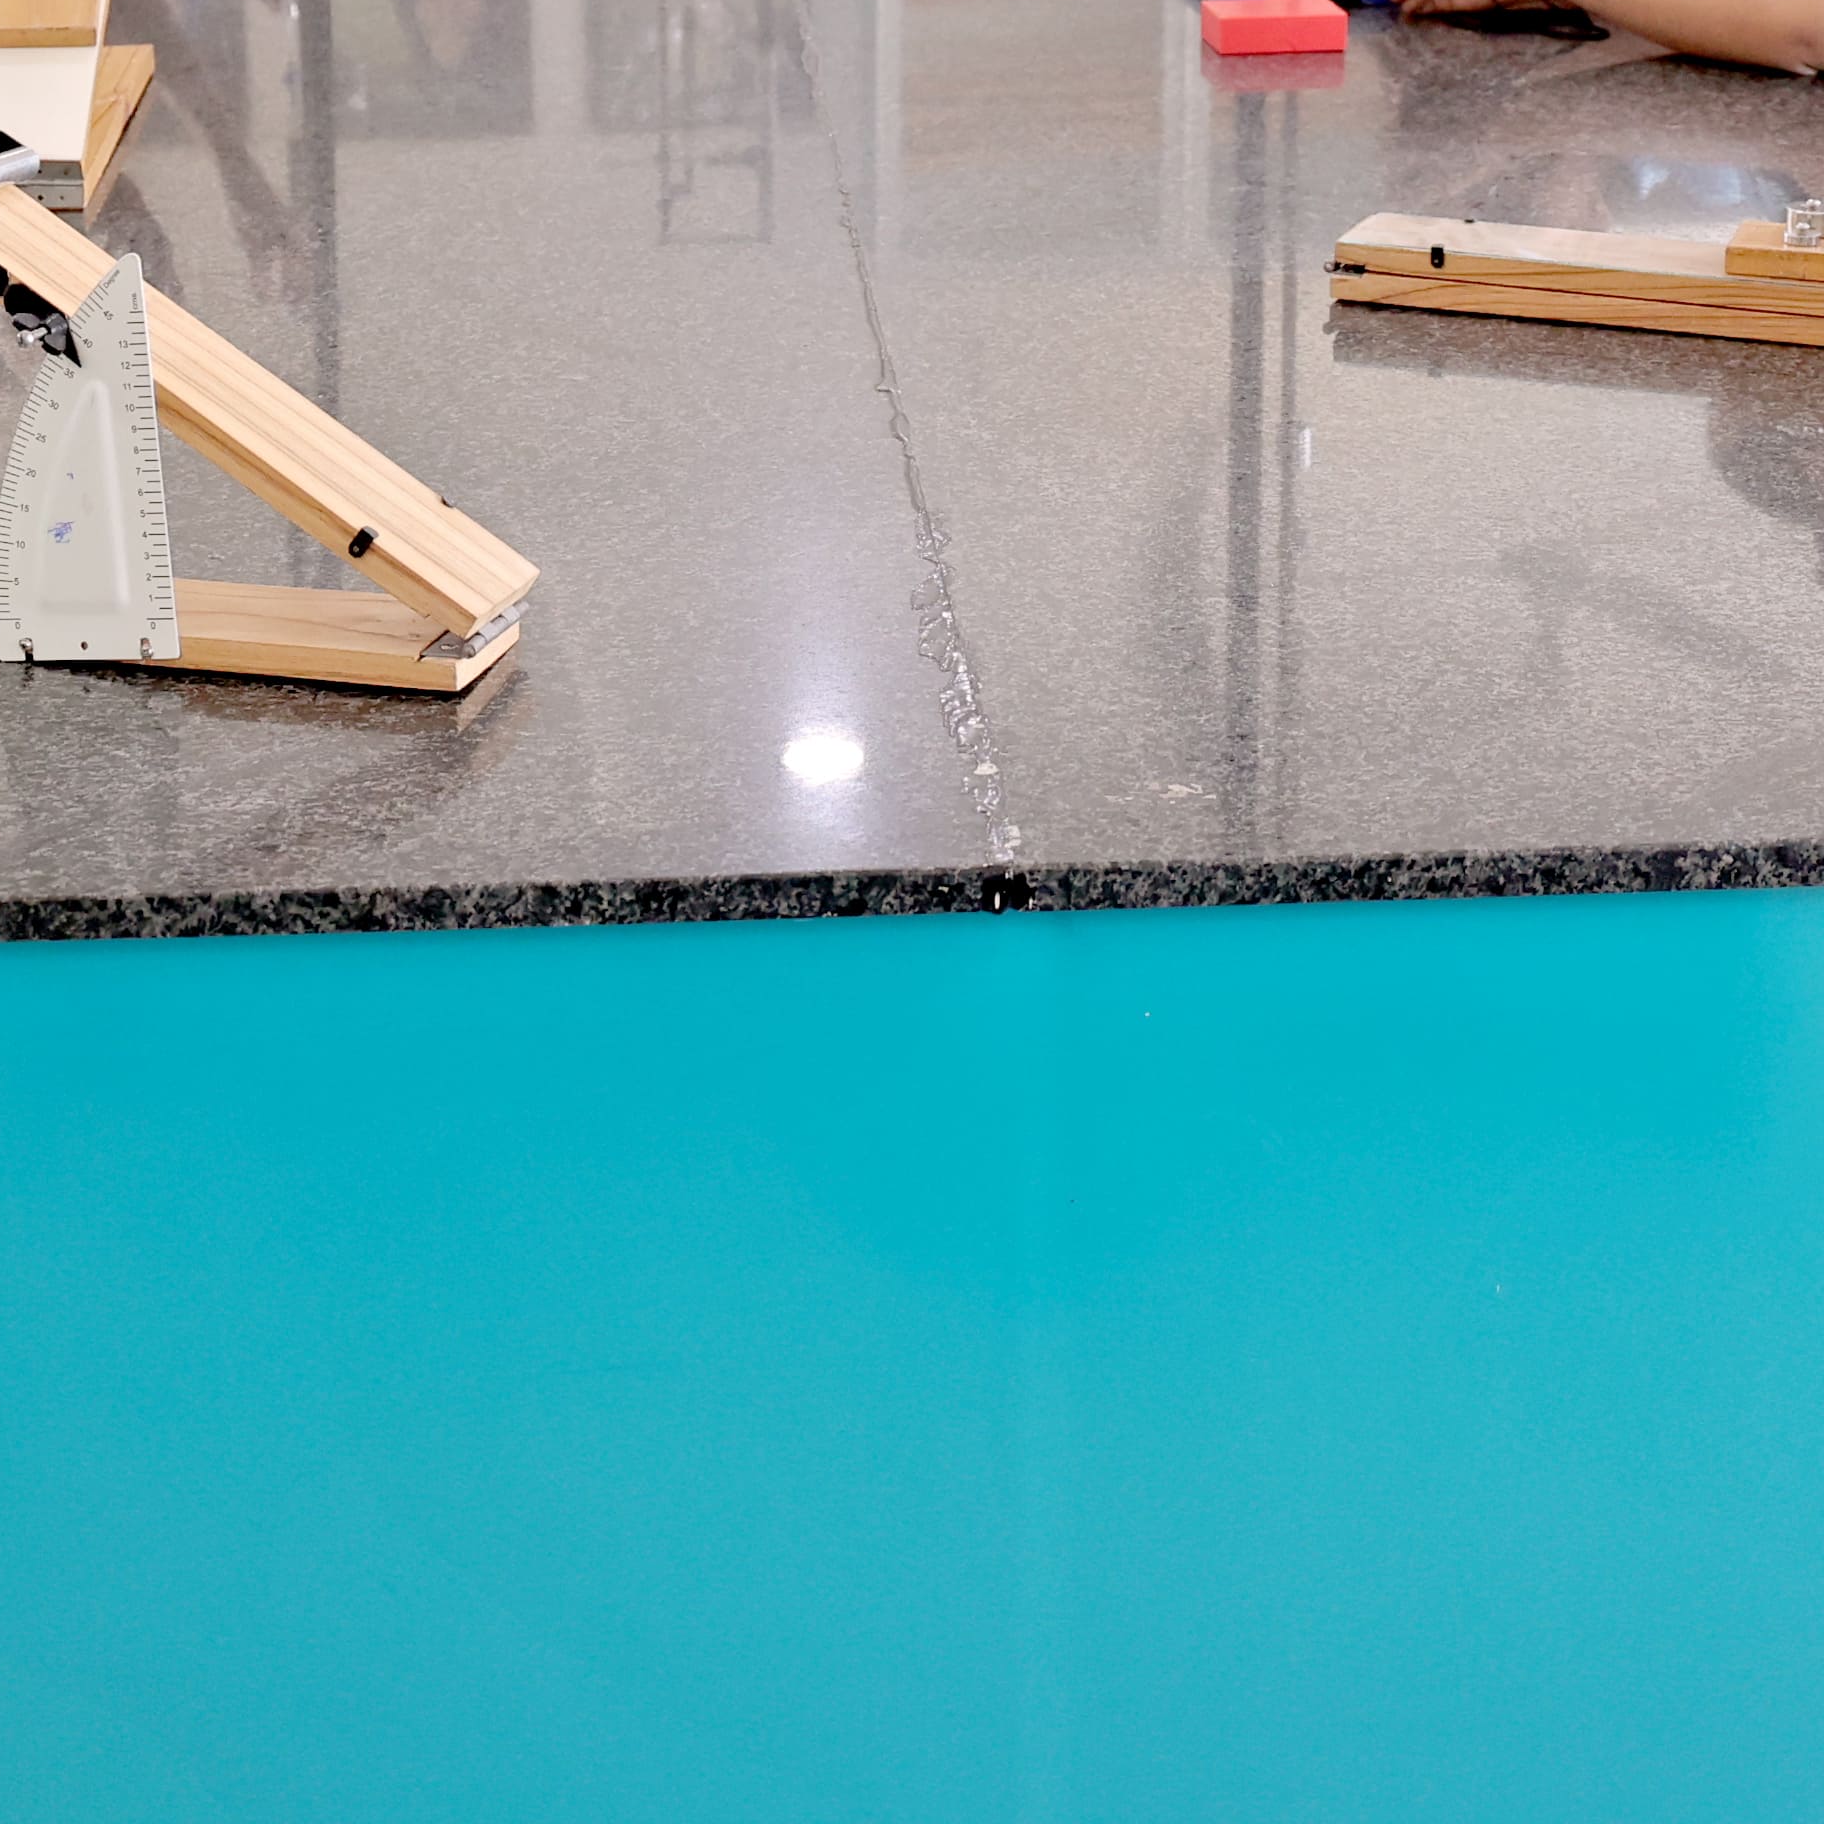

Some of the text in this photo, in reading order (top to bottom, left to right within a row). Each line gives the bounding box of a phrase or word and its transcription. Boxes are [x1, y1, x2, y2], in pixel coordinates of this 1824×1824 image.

[103, 309, 114, 322] 45
[82, 337, 94, 349] 40
[118, 340, 129, 349] 13
[120, 361, 131, 371] 12
[63, 367, 75, 379] 35
[122, 382, 132, 391] 11
[47, 399, 60, 411] 30
[124, 403, 135, 412] 10
[34, 432, 48, 444] 25
[133, 446, 139, 455] 8
[25, 467, 37, 479] 20
[137, 489, 143, 497] 6
[19, 503, 30, 513] 15
[140, 509, 146, 518] 5
[15, 540, 26, 550] 10
[144, 552, 150, 560] 3
[14, 577, 20, 586] 5
[146, 573, 152, 581] 2
[15, 622, 21, 630] 0
[150, 622, 156, 630] 0
